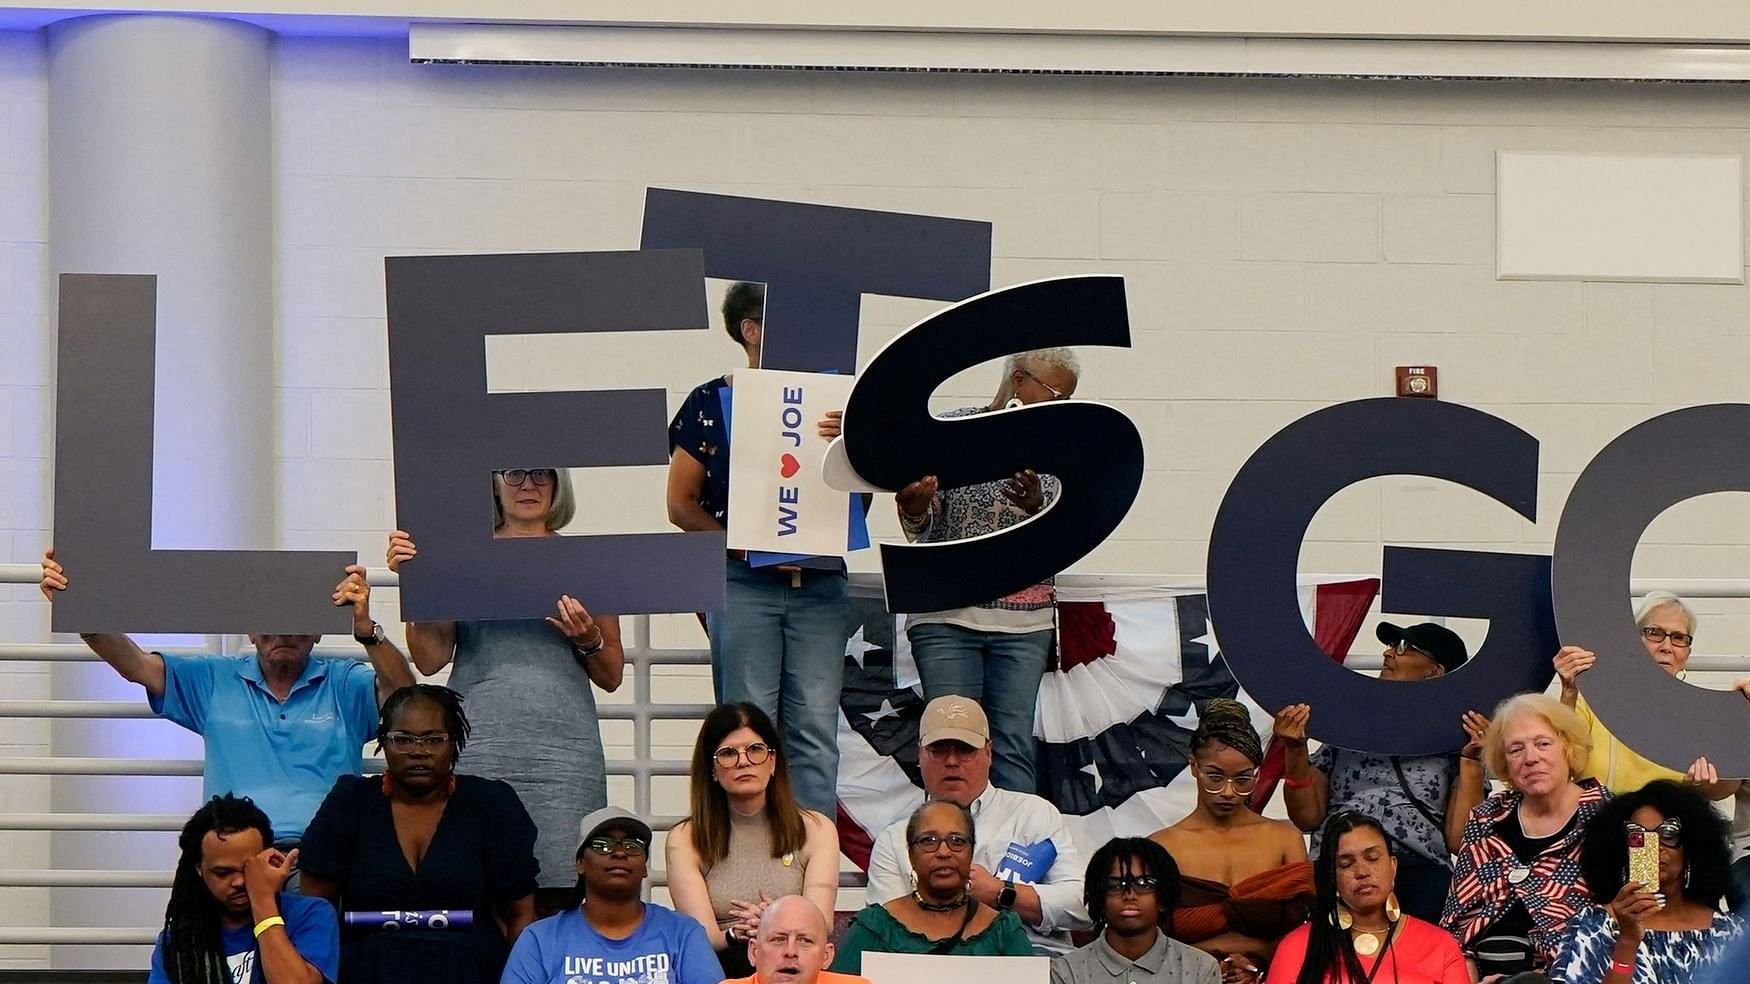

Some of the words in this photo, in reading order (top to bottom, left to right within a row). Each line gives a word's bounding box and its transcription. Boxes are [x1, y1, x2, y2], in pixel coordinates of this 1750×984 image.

[782, 387, 803, 447] JOE
[778, 486, 799, 537] WE
[565, 956, 603, 976] LIVE
[606, 953, 669, 977] UNITED
